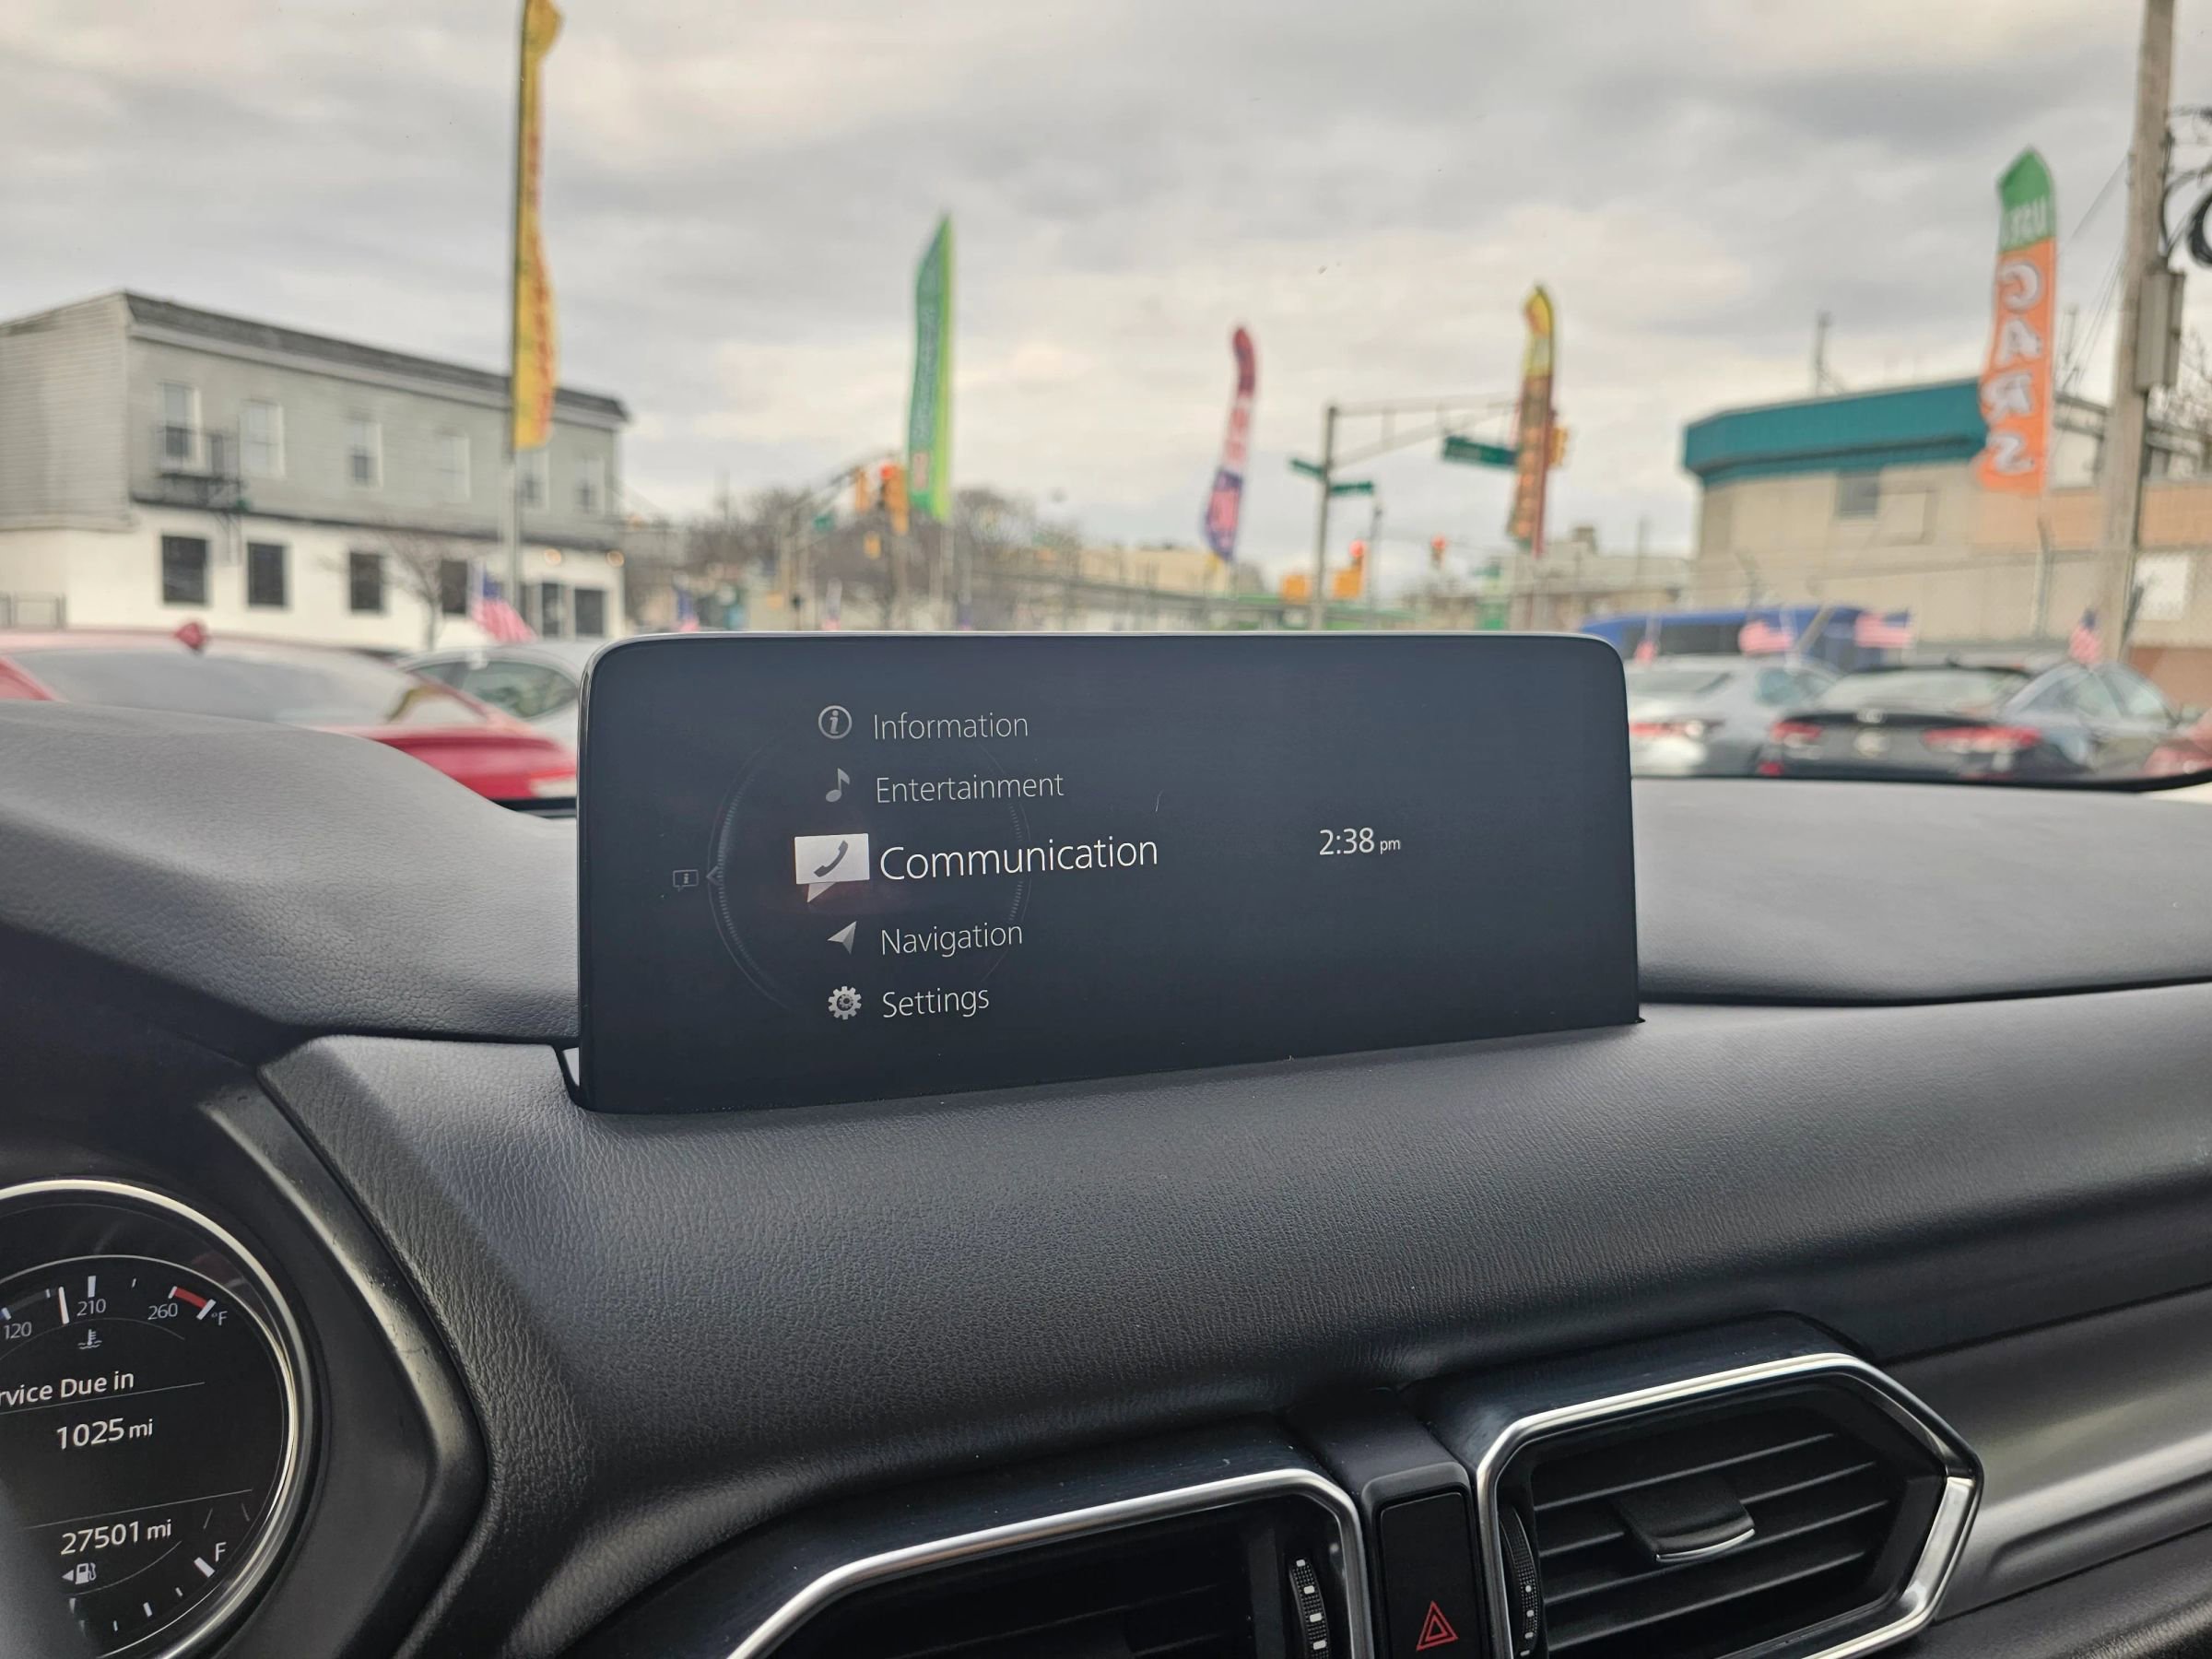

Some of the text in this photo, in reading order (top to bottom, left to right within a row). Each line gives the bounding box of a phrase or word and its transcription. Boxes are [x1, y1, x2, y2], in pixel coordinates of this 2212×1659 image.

[873, 712, 1030, 740] Information
[877, 773, 1065, 804] Entertainment
[1319, 827, 1401, 855] 2:38 pm
[879, 835, 1159, 881] Communication
[880, 921, 1024, 958] Navigation
[882, 986, 991, 1018] Settings
[76, 1298, 107, 1317] 210
[147, 1302, 179, 1320] 260
[3, 1321, 33, 1341] 120
[60, 1376, 108, 1399] Due
[113, 1371, 135, 1391] in
[56, 1418, 154, 1451] 1025 mi
[60, 1519, 172, 1556] 27501 mi
[215, 1541, 228, 1563] F
